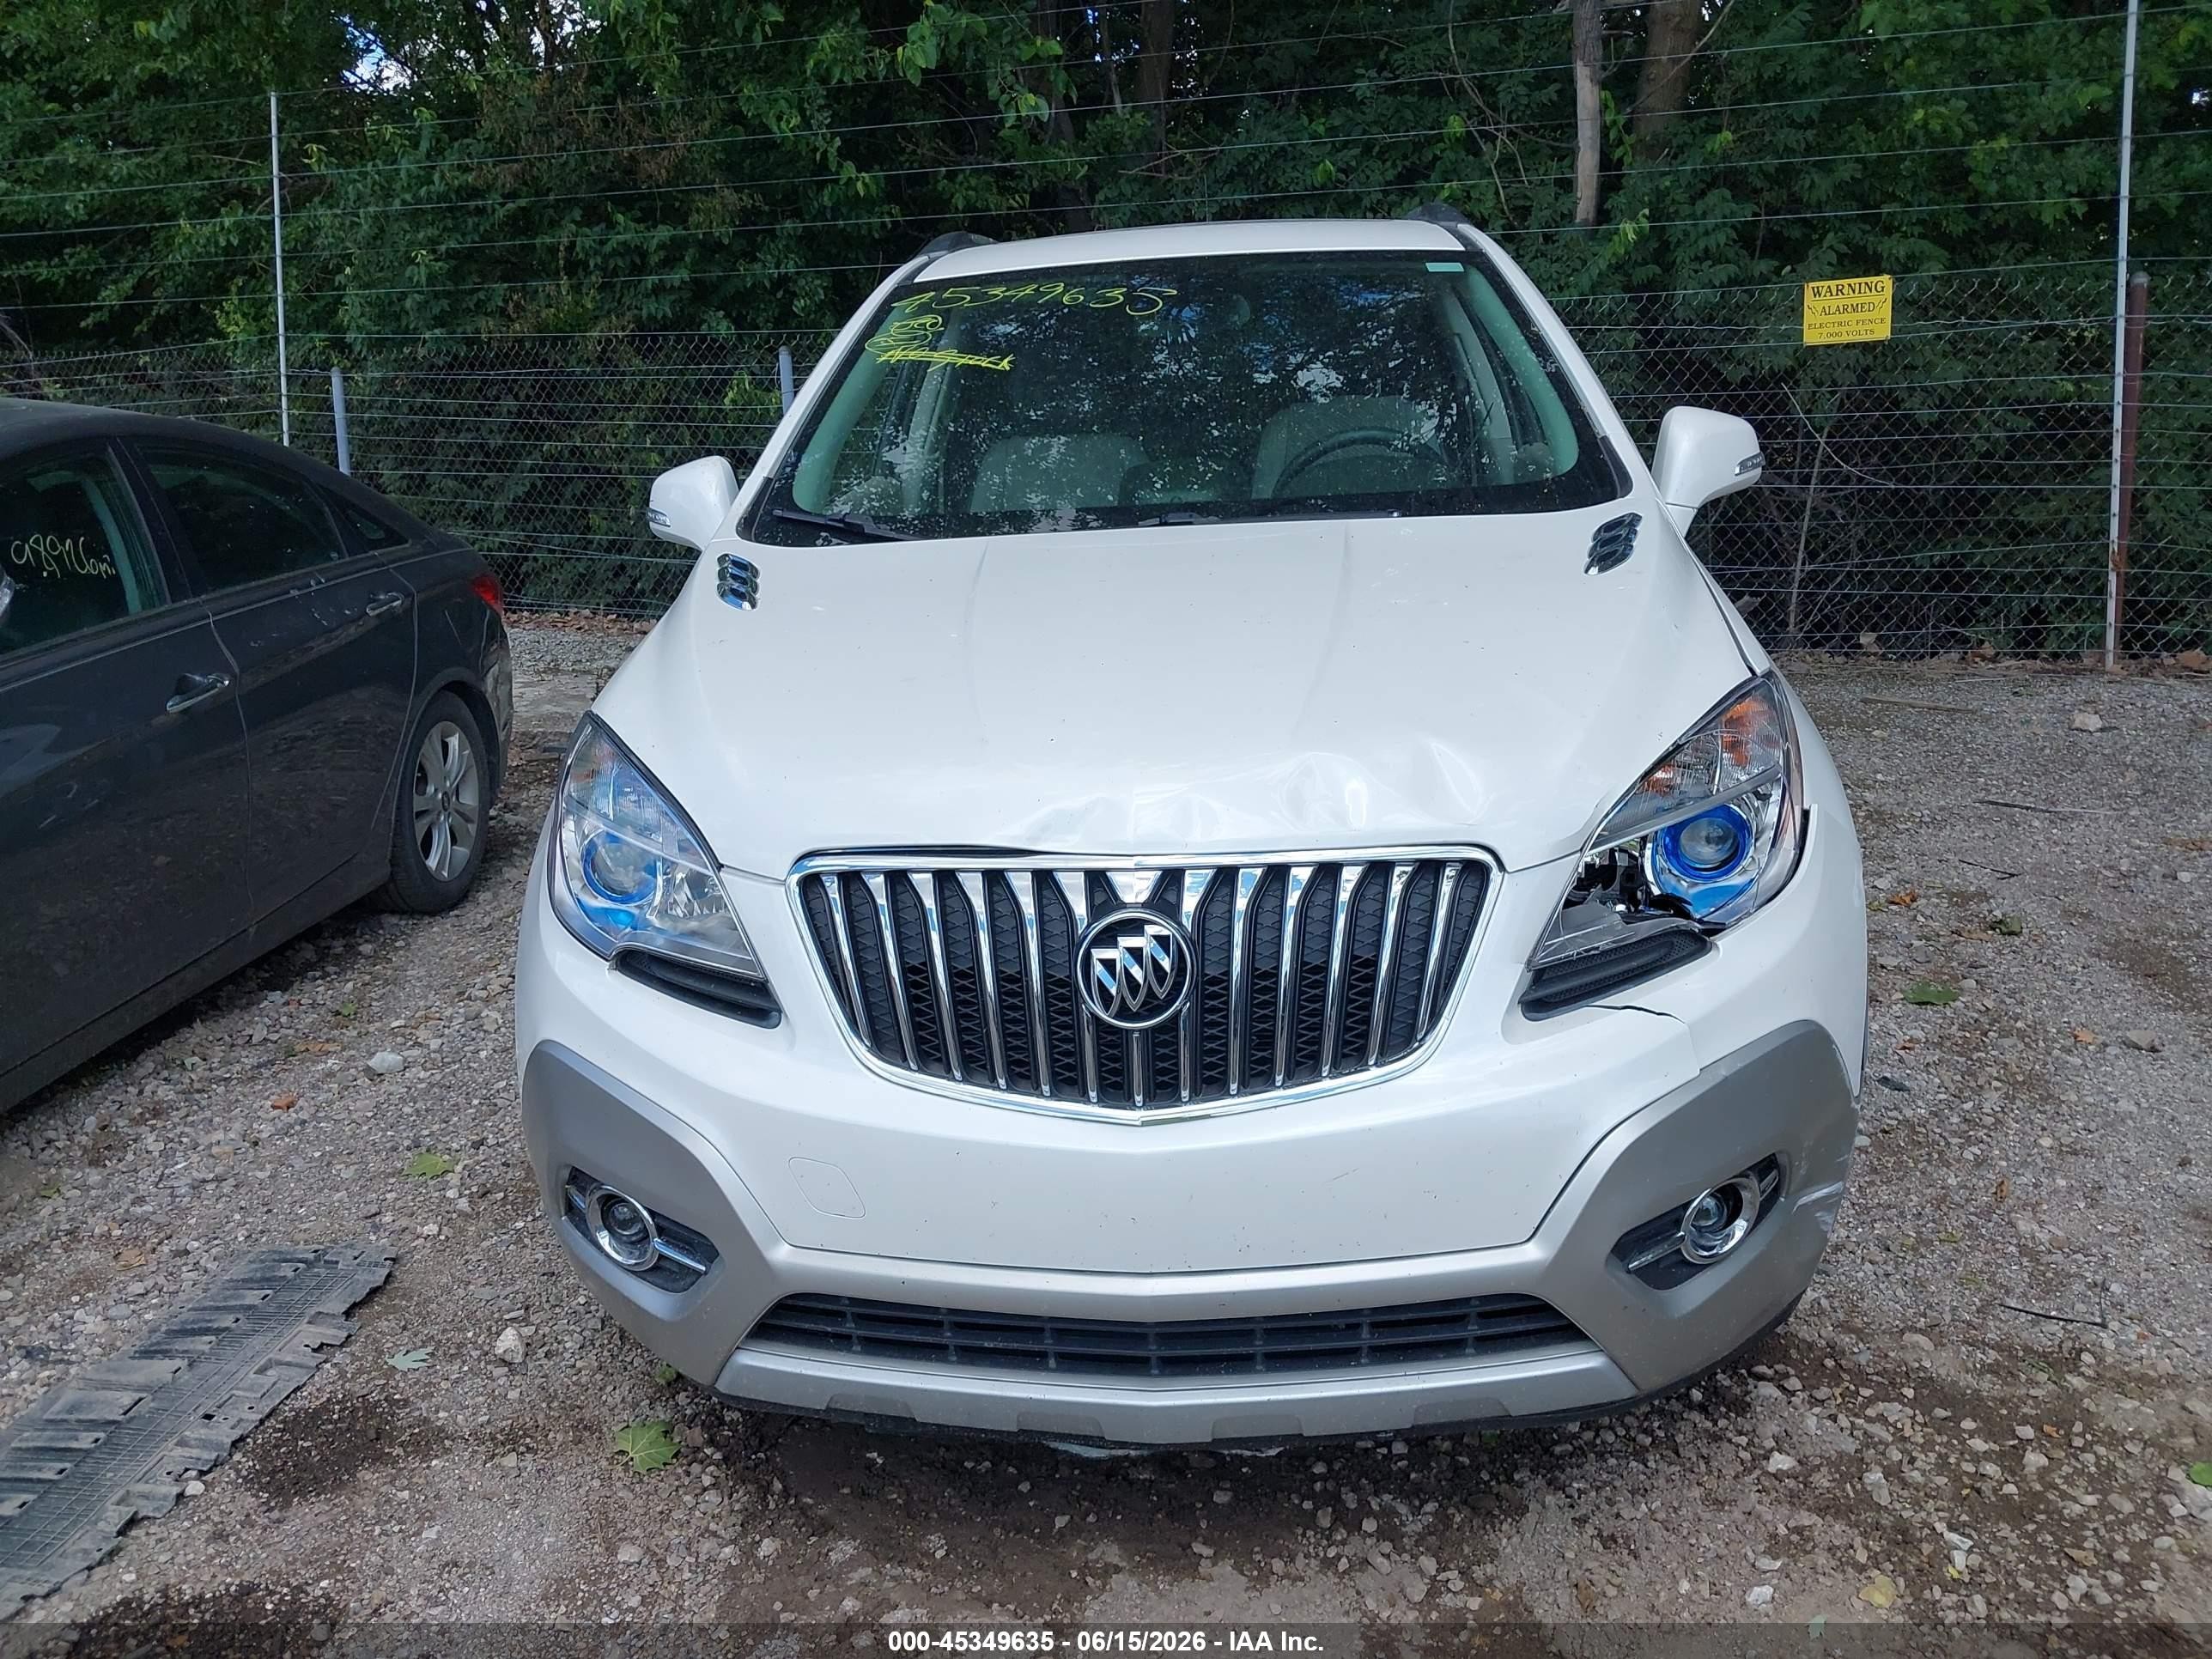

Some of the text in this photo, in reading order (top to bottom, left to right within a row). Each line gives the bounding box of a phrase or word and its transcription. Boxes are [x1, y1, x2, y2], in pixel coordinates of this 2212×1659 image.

[1811, 280, 1886, 299] WARNING
[890, 282, 1177, 315] 45349635
[1820, 301, 1875, 317] ALARMED
[1808, 317, 1887, 331] ELECTRIC FENCE
[1818, 328, 1875, 340] 7,000 VOLTS
